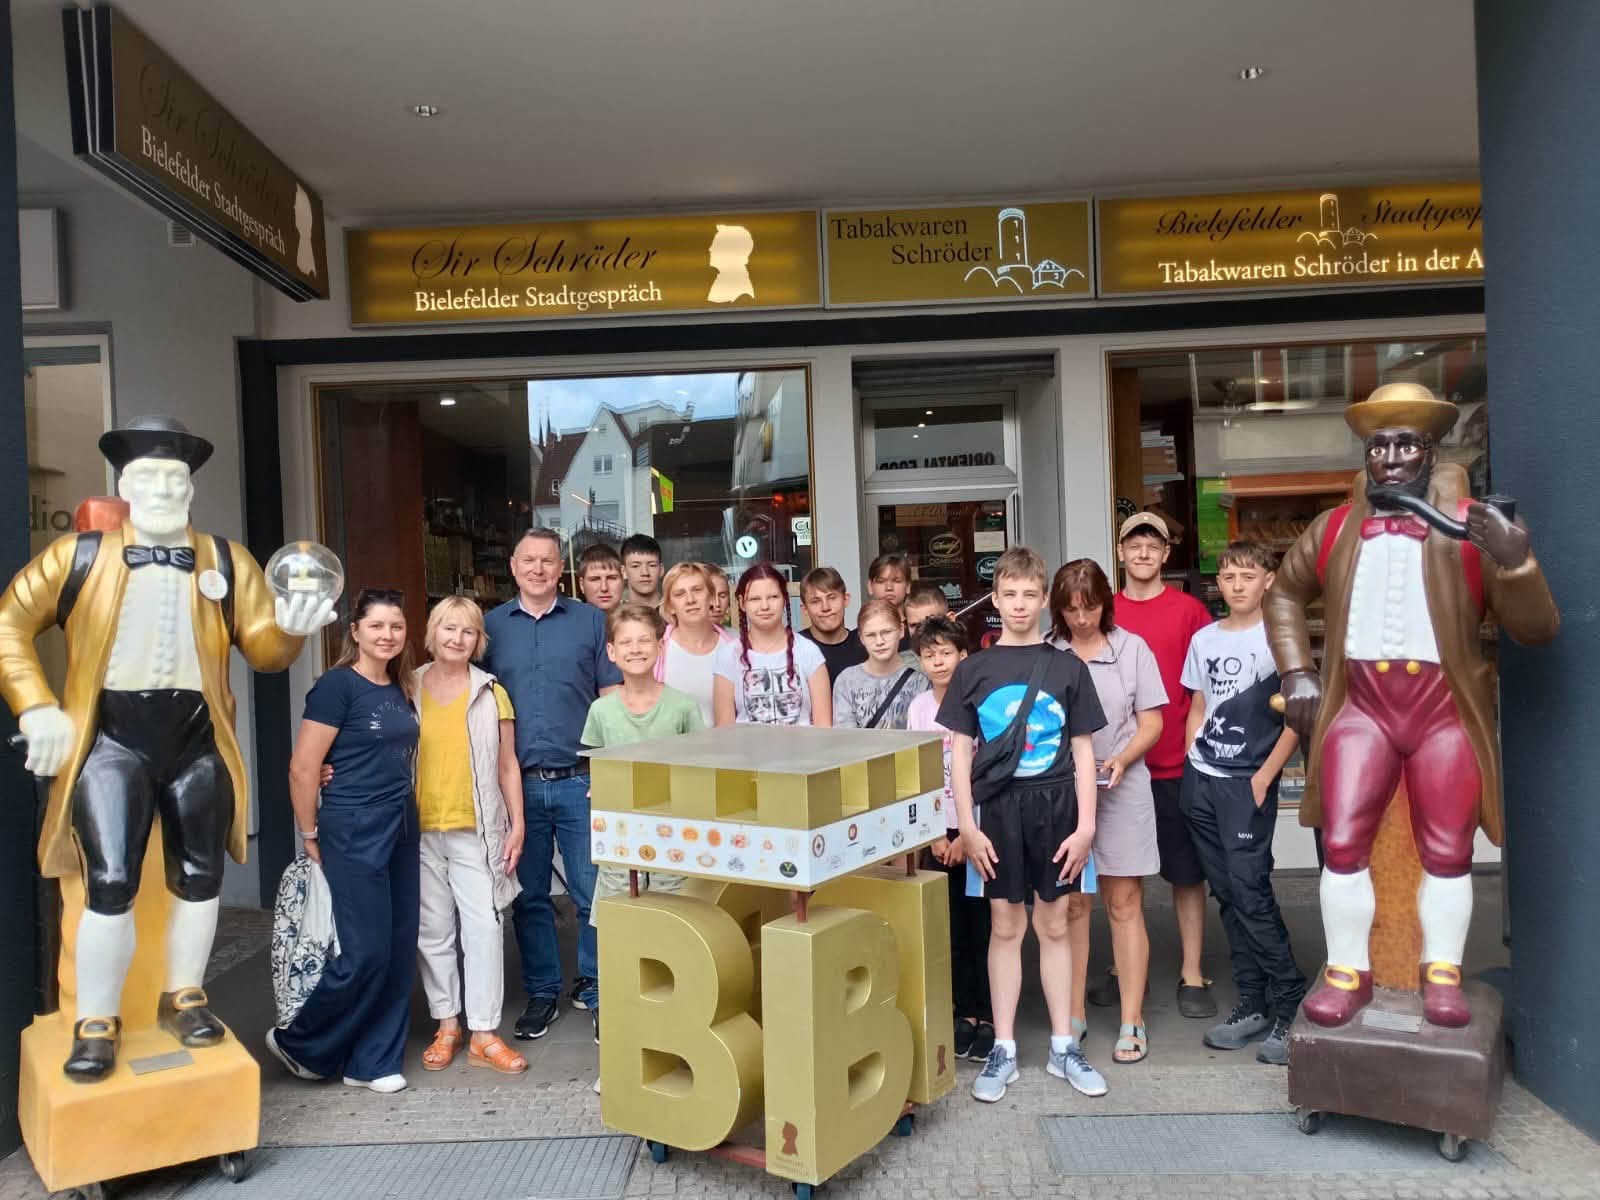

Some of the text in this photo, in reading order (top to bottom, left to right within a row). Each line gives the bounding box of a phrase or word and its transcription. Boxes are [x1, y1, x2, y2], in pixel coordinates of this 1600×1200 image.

[141, 124, 286, 256] Bielefelder Stadtgespräch
[832, 216, 968, 240] Tabakwaren
[1155, 204, 1304, 241] Bielefelder
[411, 231, 657, 288] Sir Schröder
[891, 241, 993, 265] Schröder
[1157, 259, 1287, 284] Tabakwaren
[1294, 252, 1390, 277] Schröder
[1397, 252, 1419, 272] in
[1425, 249, 1461, 271] der
[414, 280, 663, 312] Bielefelder Stadtgespräch
